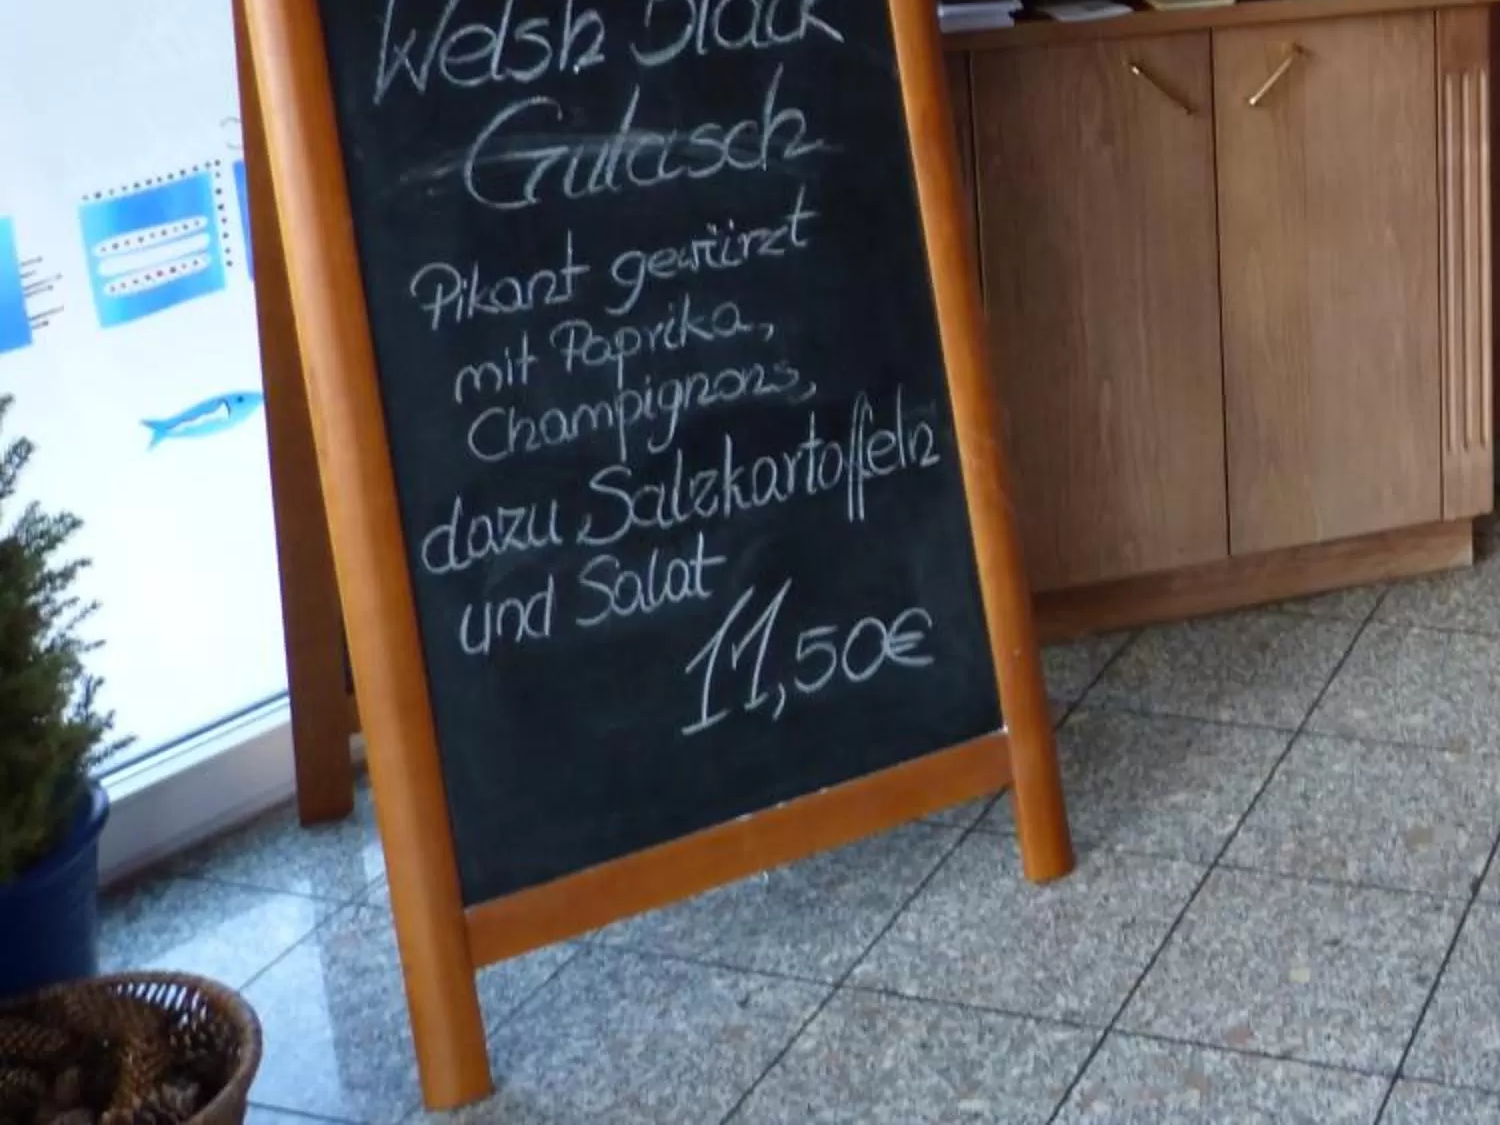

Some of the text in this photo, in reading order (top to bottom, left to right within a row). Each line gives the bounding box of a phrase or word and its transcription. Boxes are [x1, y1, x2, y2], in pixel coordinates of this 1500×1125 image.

[463, 62, 826, 209] Gulasch
[410, 184, 823, 331] Pikant gewürzt
[453, 294, 775, 404] mit Paprika,
[420, 383, 941, 575] dazu Salzkartoffeln
[458, 531, 728, 655] und Salat
[681, 577, 935, 737] 11,50€
